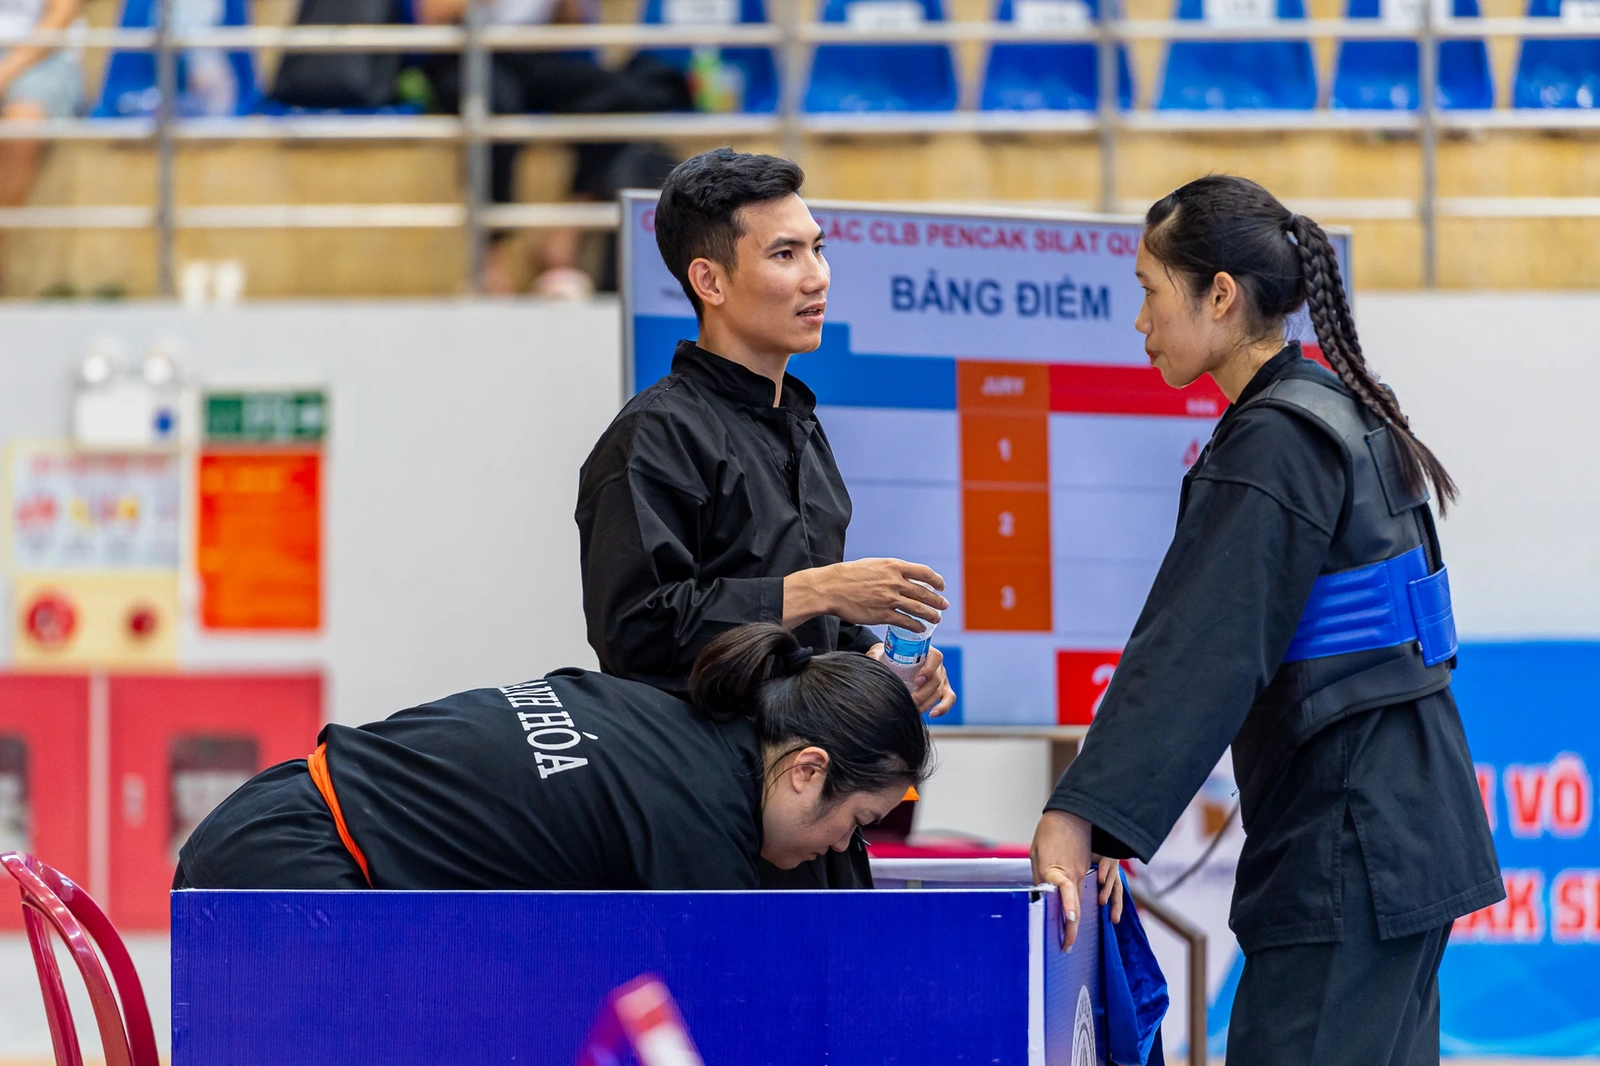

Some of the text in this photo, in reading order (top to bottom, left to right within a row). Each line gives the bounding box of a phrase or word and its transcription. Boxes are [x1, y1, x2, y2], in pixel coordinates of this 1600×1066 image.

[869, 219, 919, 246] CLB
[927, 223, 1026, 250] PENCAK
[1033, 228, 1099, 254] SILAT
[1106, 232, 1141, 257] QU
[499, 680, 599, 779] ANH HÓA
